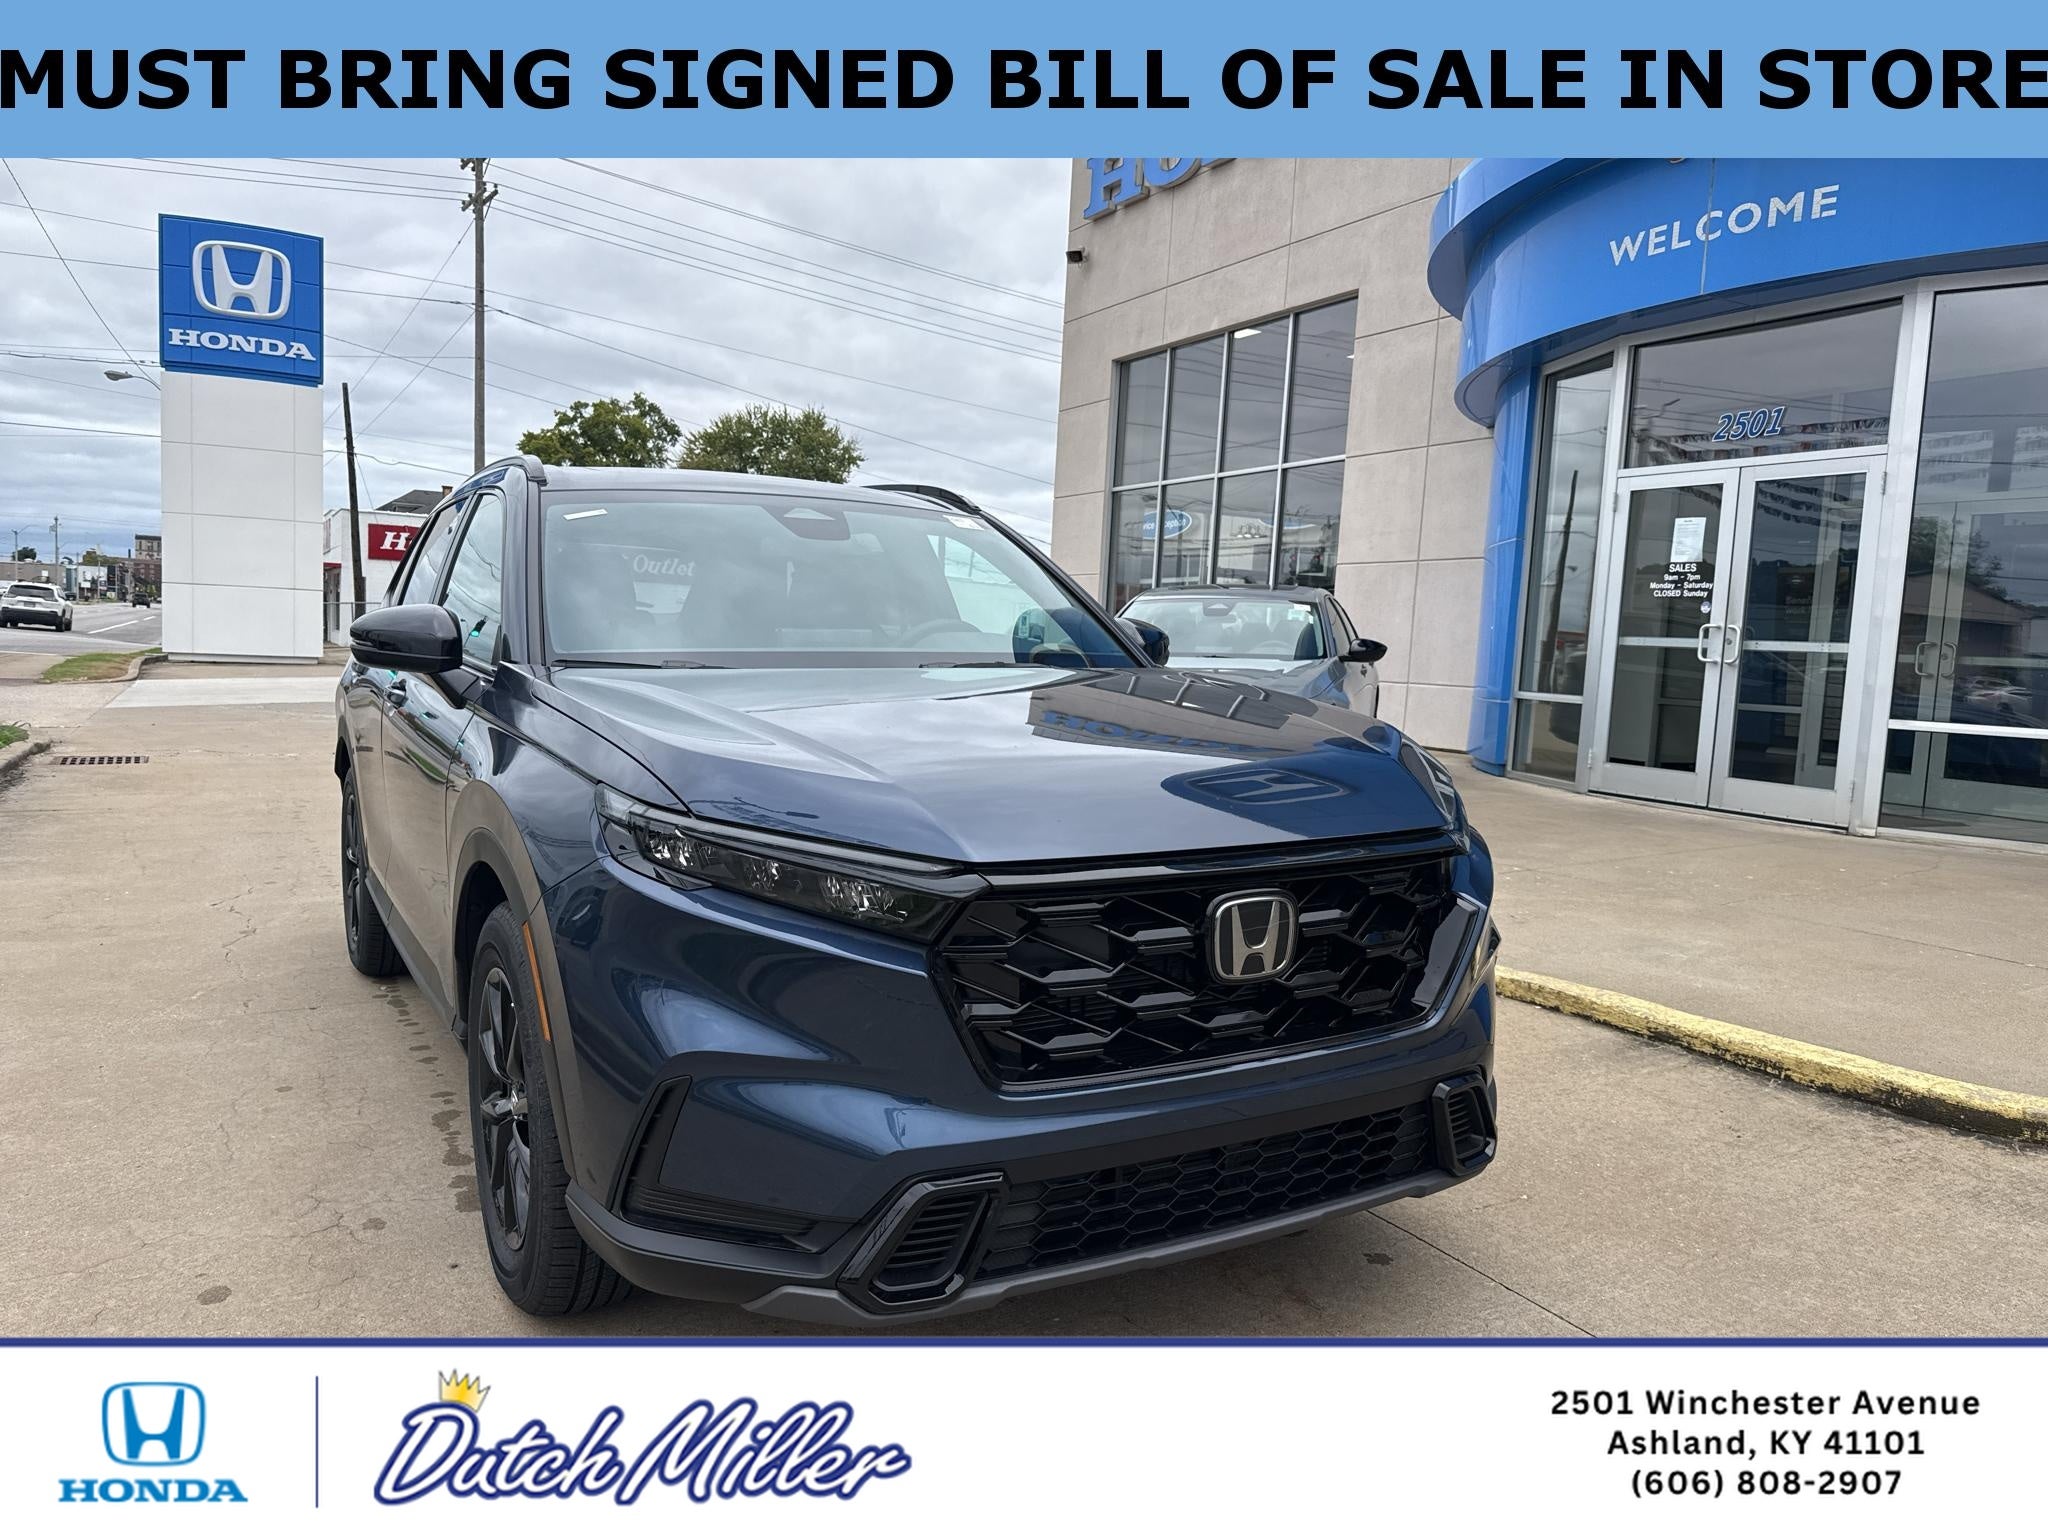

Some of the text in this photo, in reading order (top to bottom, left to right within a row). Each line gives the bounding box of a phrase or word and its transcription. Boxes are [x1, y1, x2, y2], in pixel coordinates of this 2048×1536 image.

[1609, 184, 1840, 267] WELCOME
[168, 328, 317, 361] HONDA
[1711, 405, 1786, 443] 2501
[633, 554, 697, 576] Outlet
[1669, 563, 1697, 572] SALES
[1663, 573, 1679, 581] 9am
[1686, 573, 1701, 581] 7pm
[1683, 581, 1713, 589] Saturday
[1683, 590, 1709, 598] Sunday
